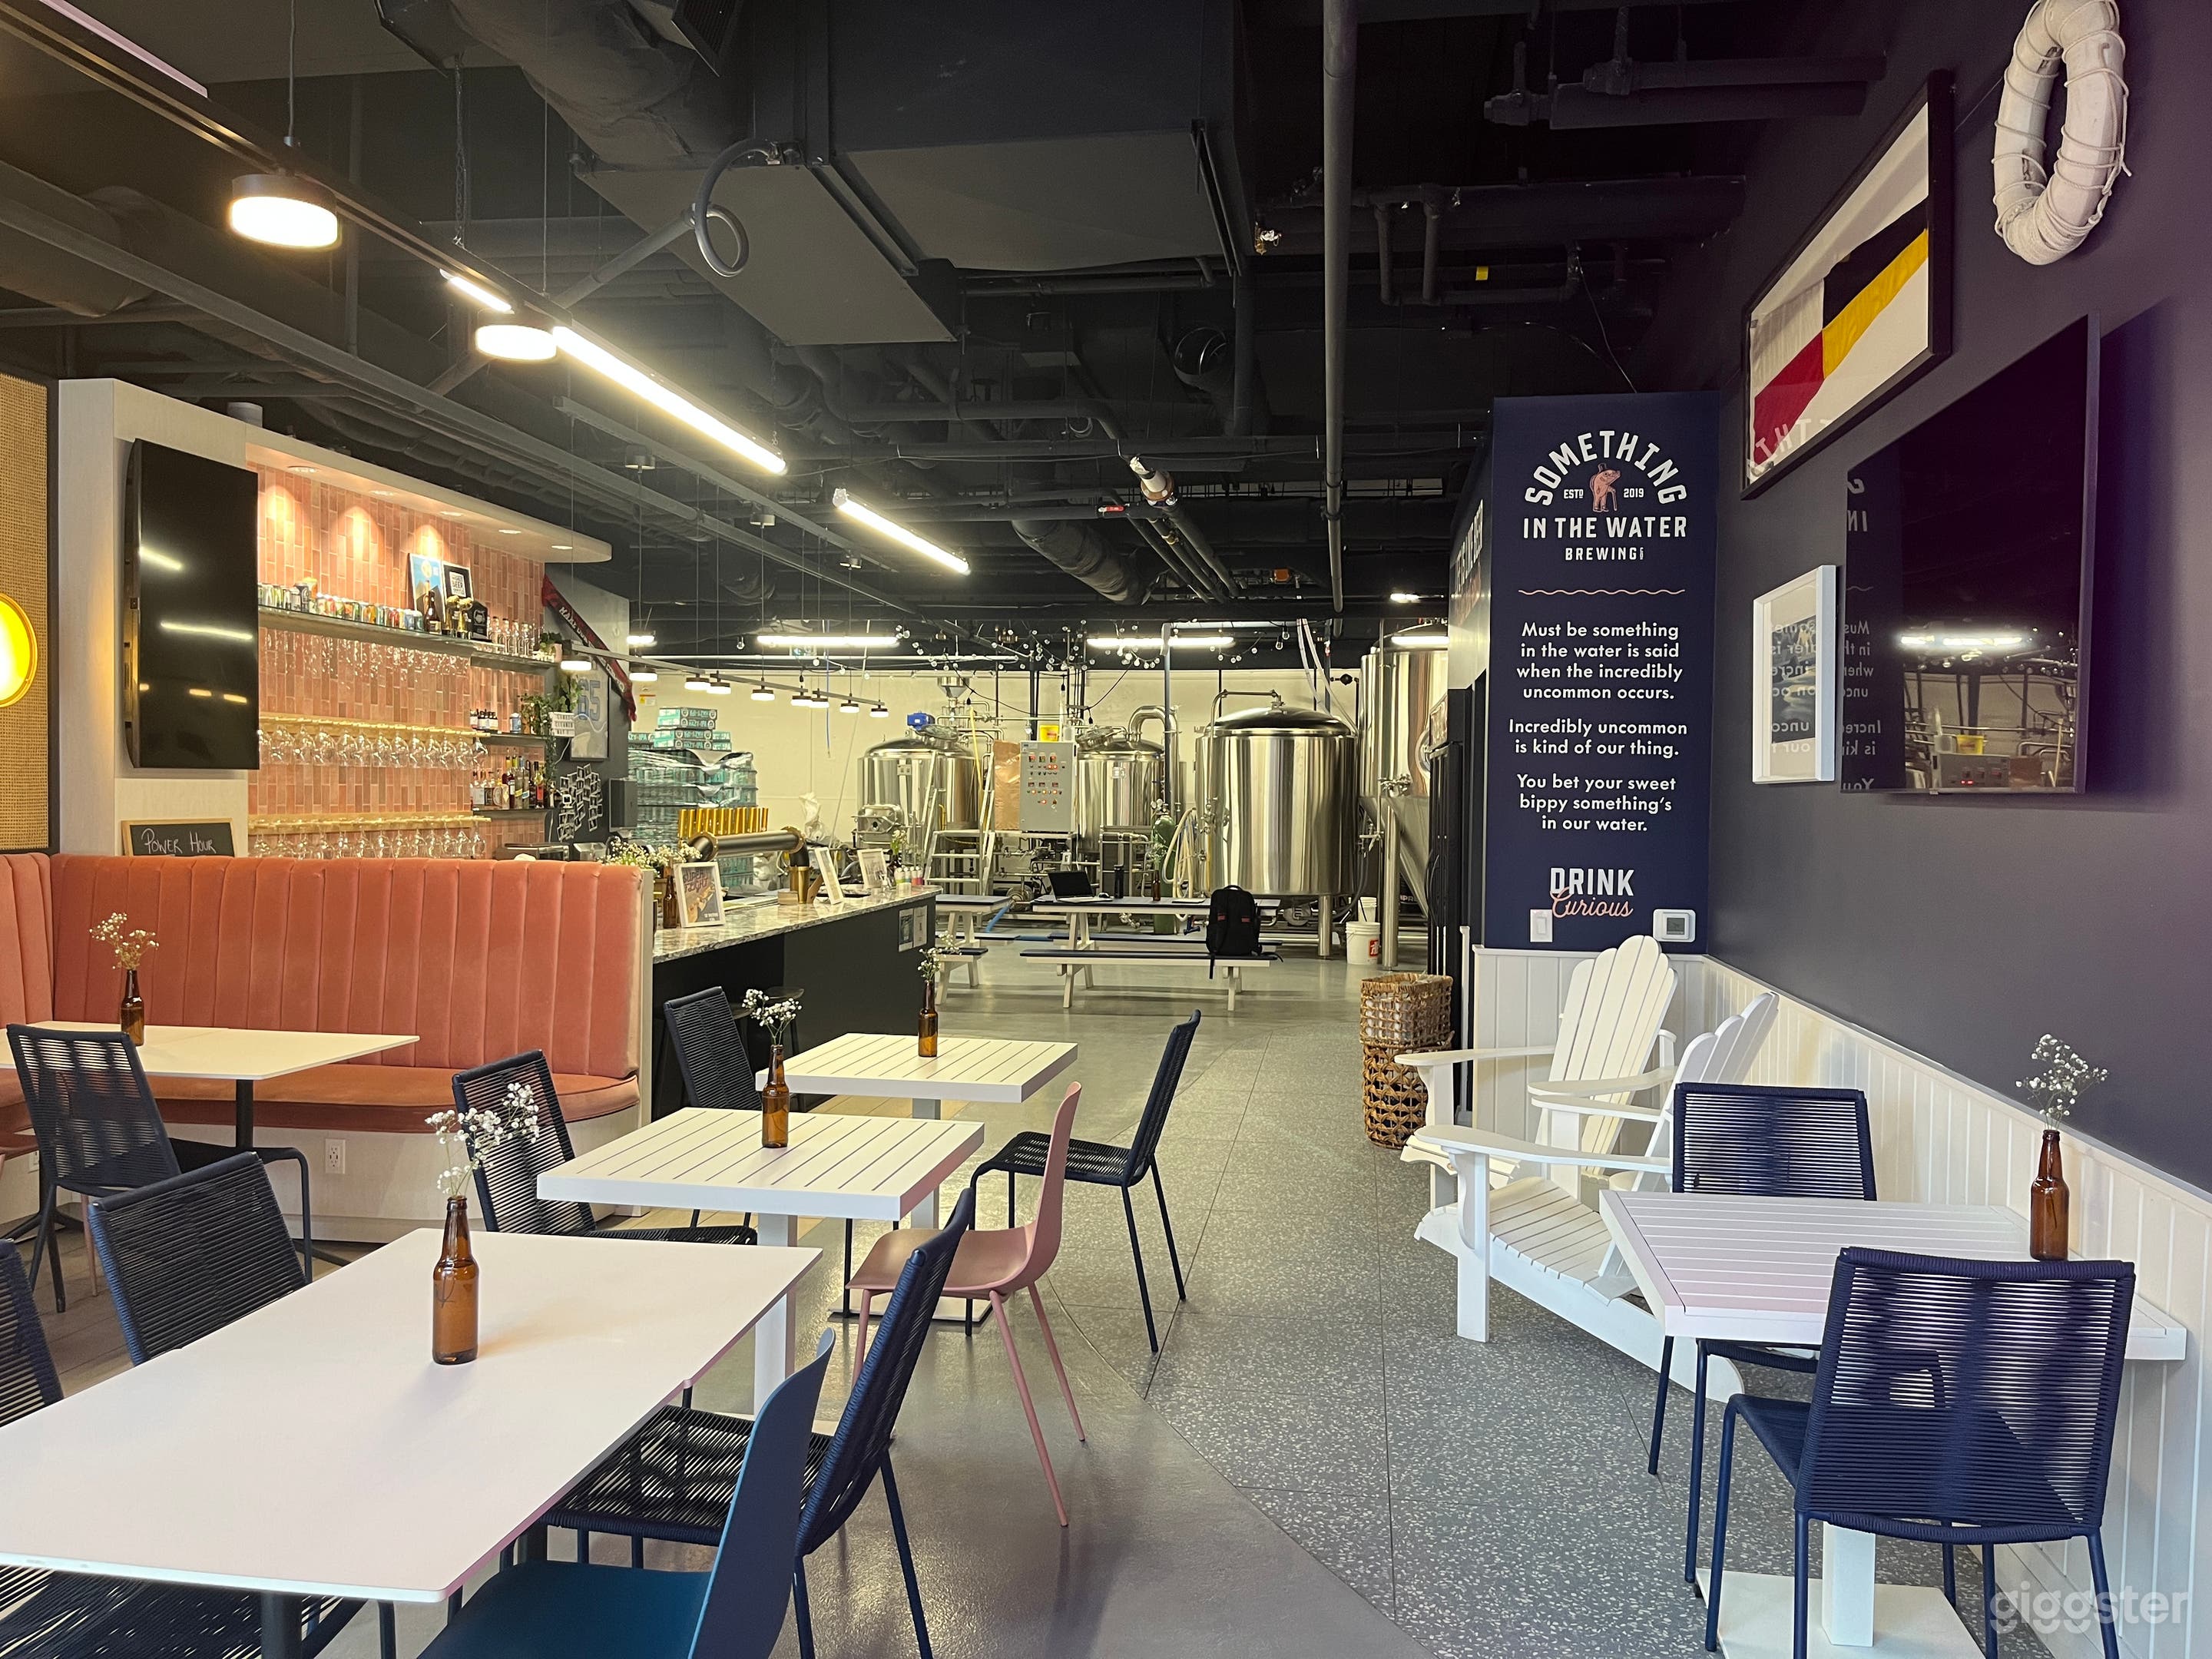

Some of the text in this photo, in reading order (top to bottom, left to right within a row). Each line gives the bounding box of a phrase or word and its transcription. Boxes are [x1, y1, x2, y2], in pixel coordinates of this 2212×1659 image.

[1525, 430, 1687, 505] SOMETHING
[1623, 488, 1644, 498] 2019
[1523, 516, 1687, 539] IN THE WATER
[1565, 547, 1637, 561] BREWING
[1522, 621, 1679, 641] Must be something
[1521, 641, 1679, 657] in the water is said
[1516, 662, 1683, 683] when the incredibly
[1523, 688, 1674, 700] uncommon occurs.
[1509, 717, 1687, 737] Incredibly uncommon
[1515, 738, 1679, 759] is kind of our thing.
[1516, 773, 1677, 793] You bet your sweet
[1519, 793, 1672, 815] bippy something's
[1541, 814, 1647, 832] in our water.
[141, 828, 216, 854] POWER HOUR
[1550, 868, 1634, 896] DRINK
[1550, 886, 1633, 918] Curious
